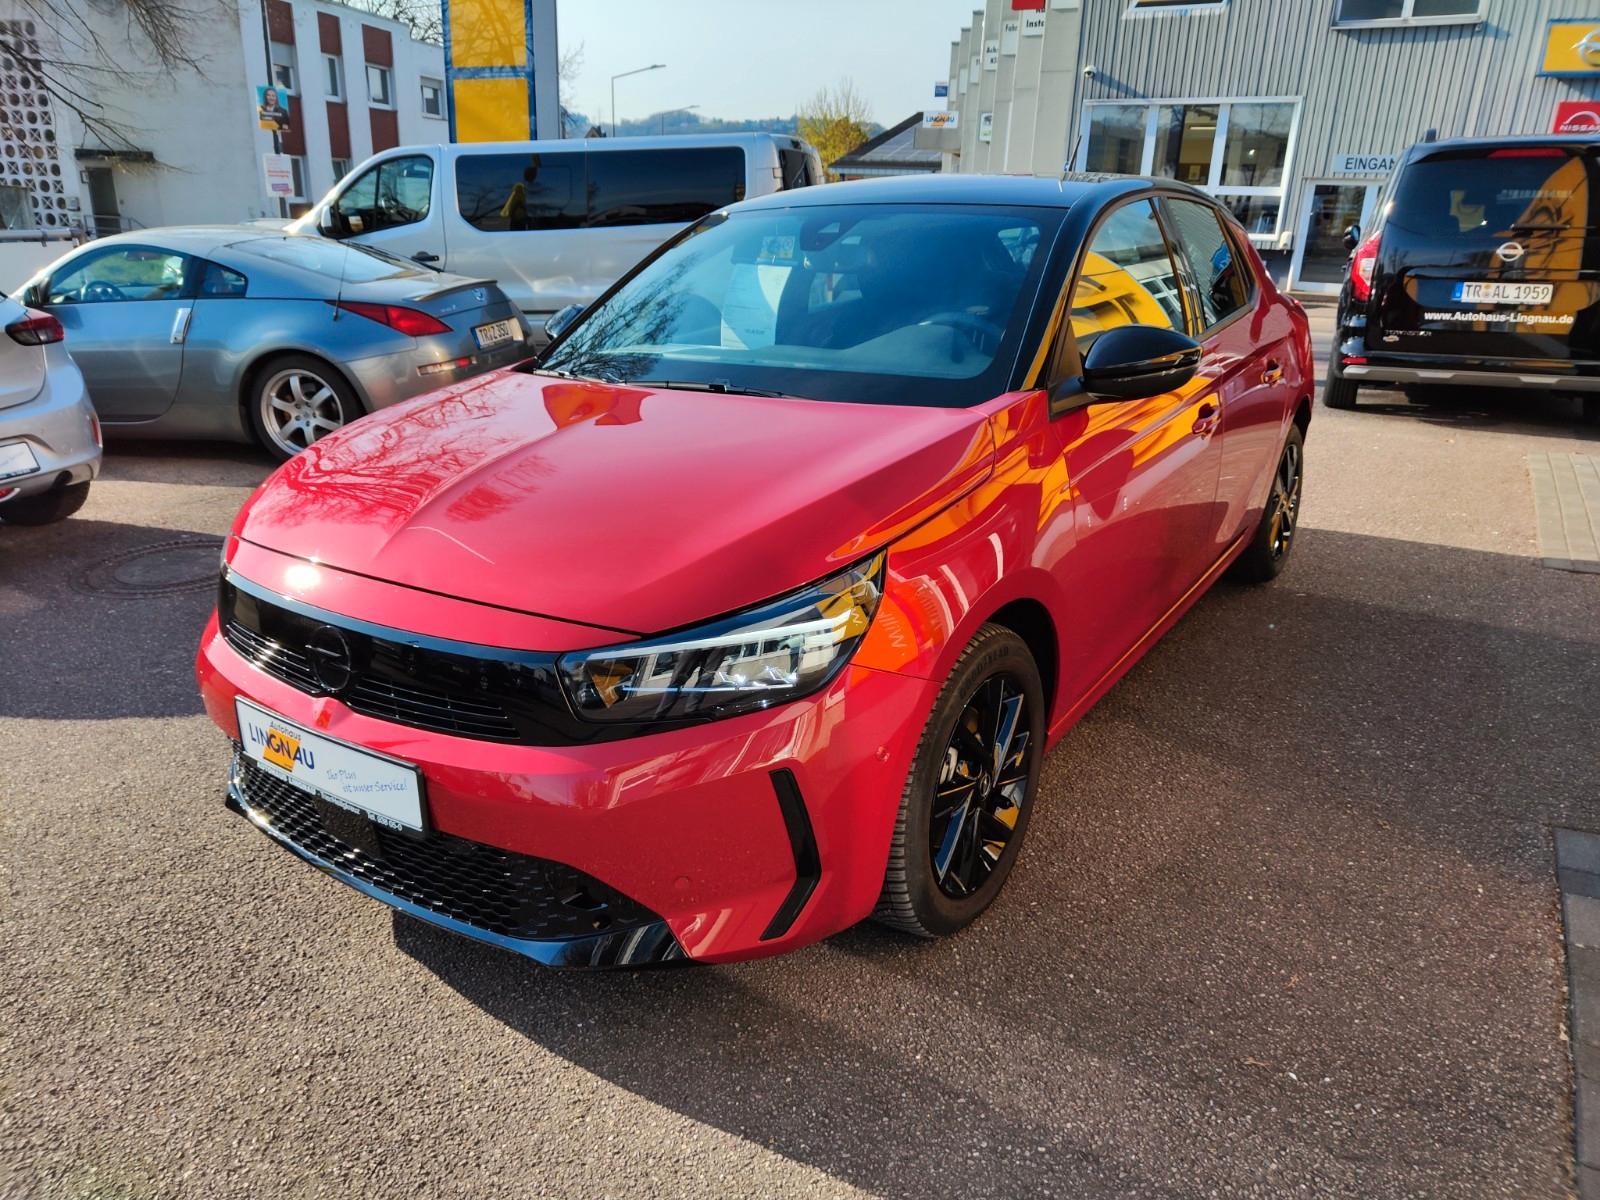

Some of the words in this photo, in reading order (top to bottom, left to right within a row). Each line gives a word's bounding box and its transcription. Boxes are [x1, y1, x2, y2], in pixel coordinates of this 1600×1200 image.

[1465, 284, 1482, 298] TR
[1492, 286, 1510, 299] AL
[1514, 286, 1550, 300] 1959
[1424, 311, 1574, 325] www.Autohaus-Lingnau.de
[271, 721, 302, 740] Autohaus
[248, 722, 315, 769] LINGNAU
